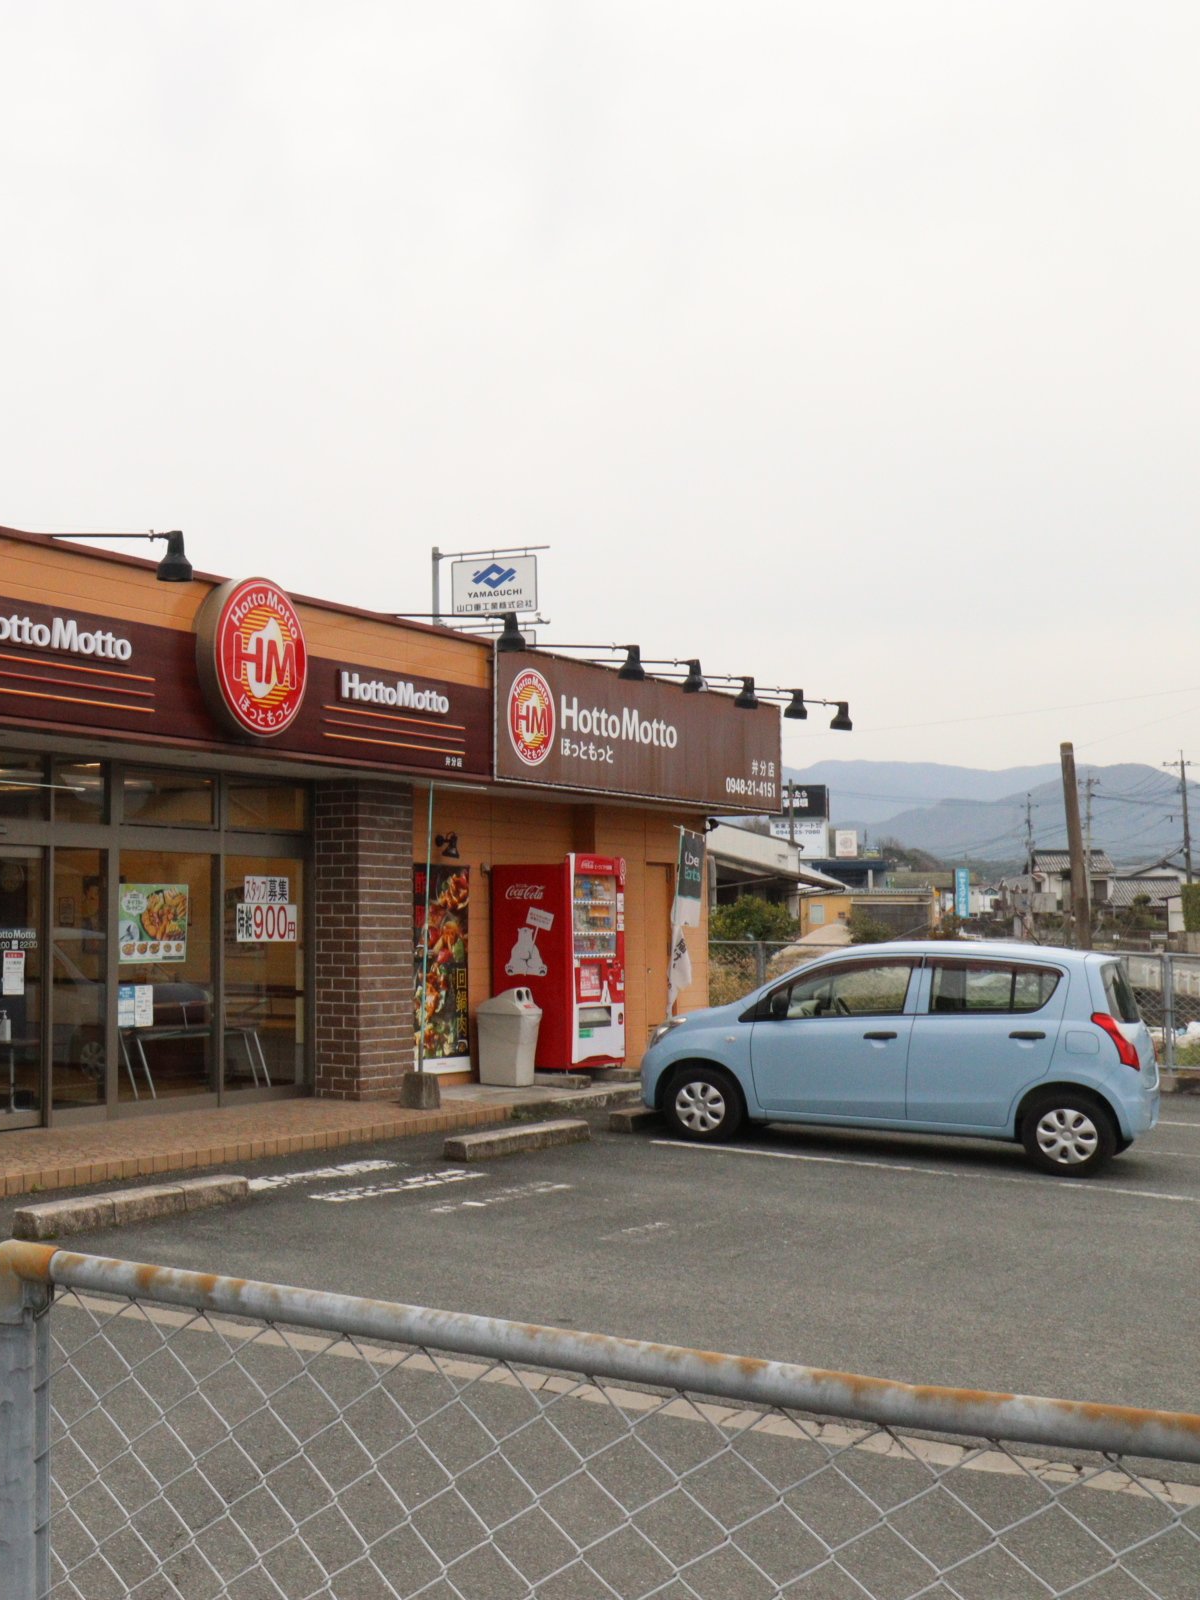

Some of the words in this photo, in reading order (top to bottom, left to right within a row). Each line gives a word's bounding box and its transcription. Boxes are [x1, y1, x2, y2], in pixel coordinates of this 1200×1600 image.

[467, 588, 523, 599] YAMAGUCHI
[230, 590, 298, 640] HottoMotto
[232, 631, 297, 691] HM
[238, 693, 292, 726] ほっともっと
[560, 738, 614, 764] ほっともっと
[725, 777, 776, 798] 0948-21-4151
[456, 967, 468, 1038] 回鍋肉
